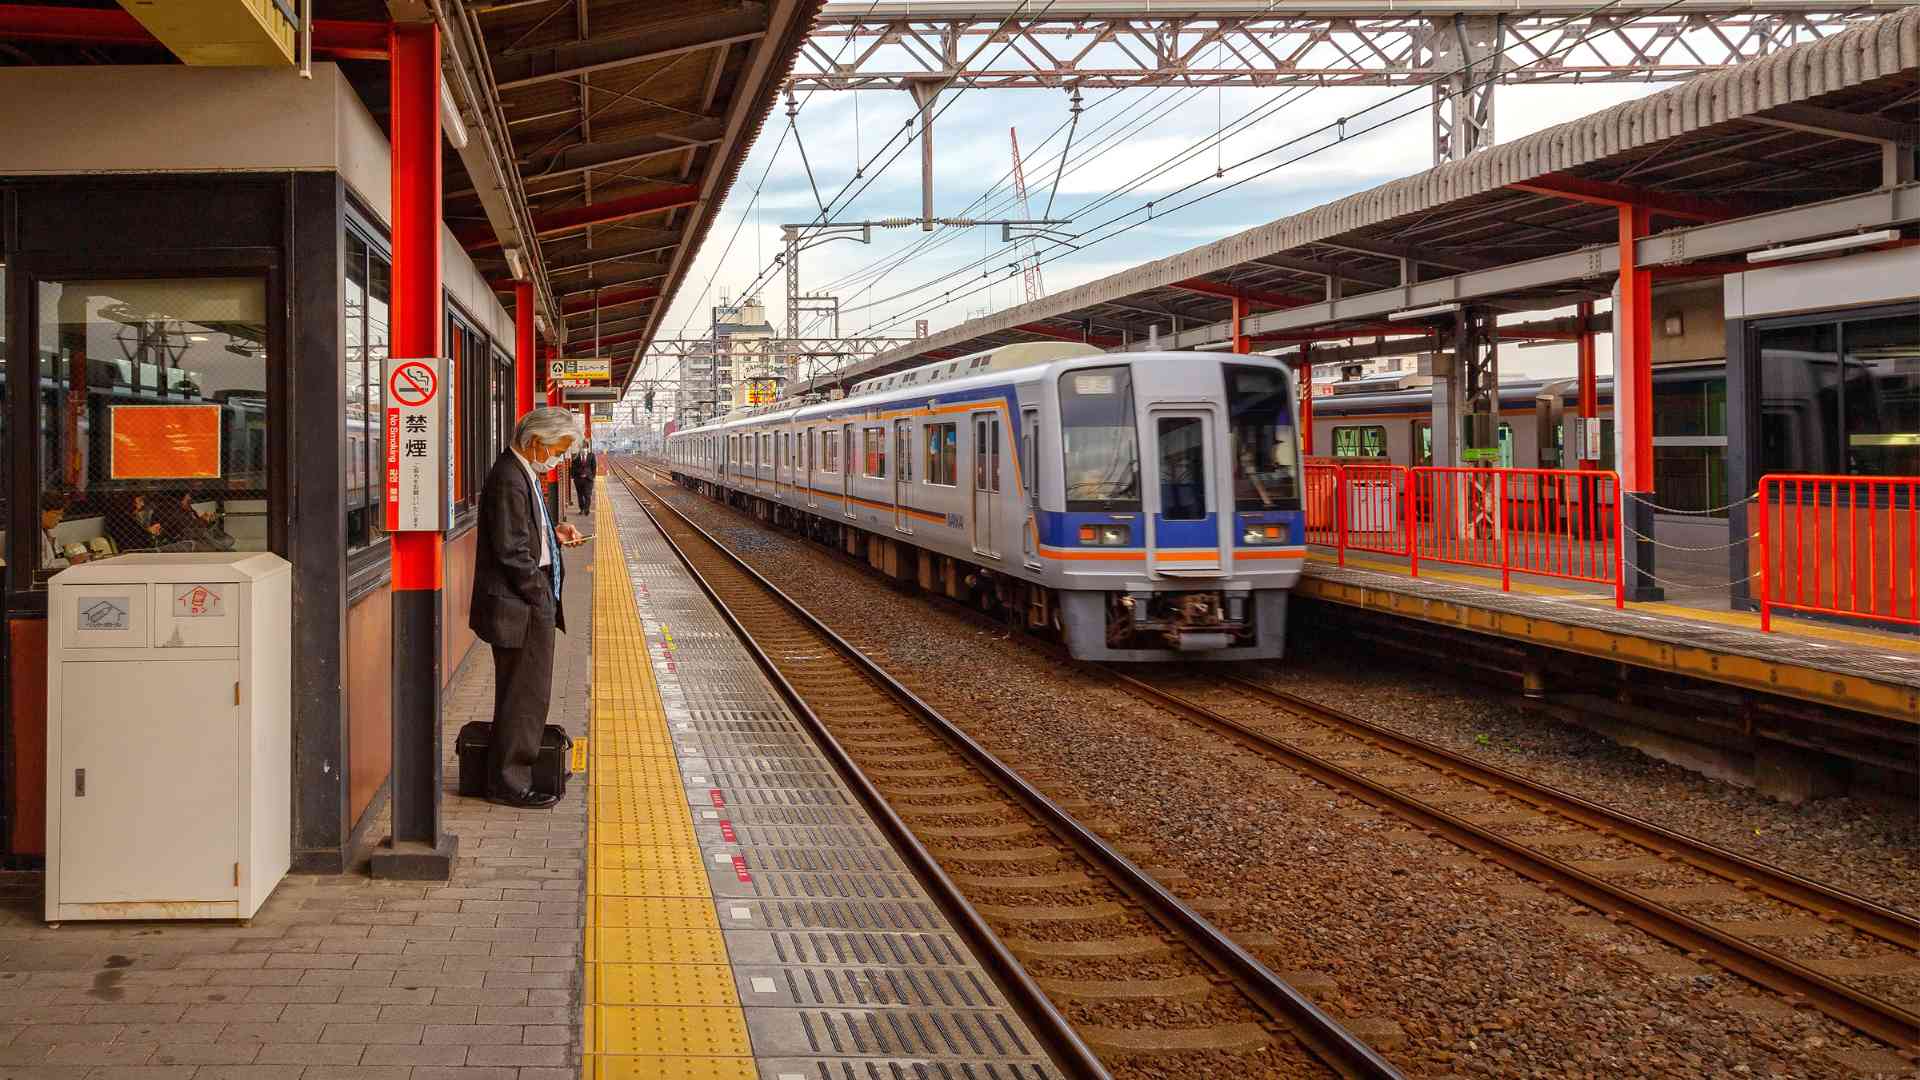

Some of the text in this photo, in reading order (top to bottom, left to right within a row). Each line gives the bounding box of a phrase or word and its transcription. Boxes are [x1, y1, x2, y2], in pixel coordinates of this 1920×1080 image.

[390, 414, 399, 426] No
[405, 414, 427, 458] 禁煙
[387, 426, 399, 463] Smoking
